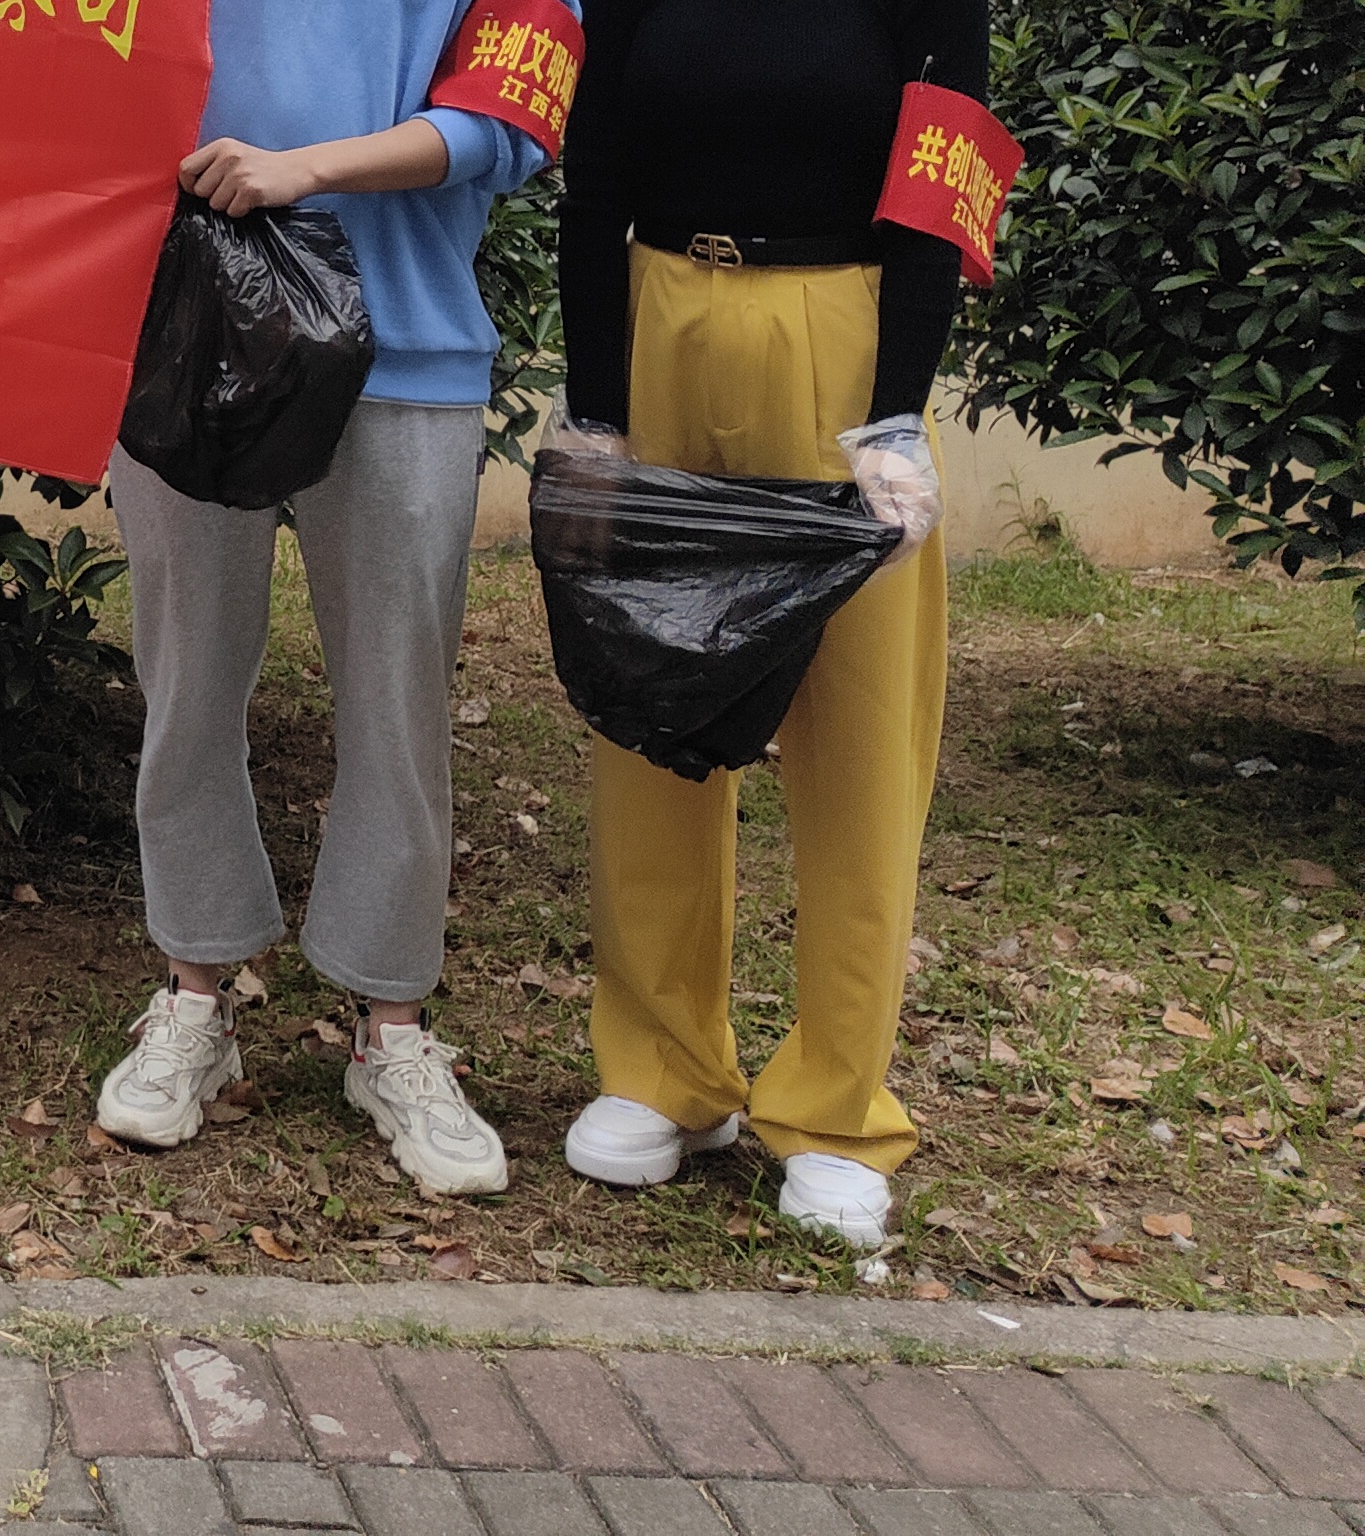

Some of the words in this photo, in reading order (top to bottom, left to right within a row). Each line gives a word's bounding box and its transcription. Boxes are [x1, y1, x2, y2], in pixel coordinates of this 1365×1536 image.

[468, 19, 578, 113] 共创文明城
[498, 74, 566, 145] 江西华
